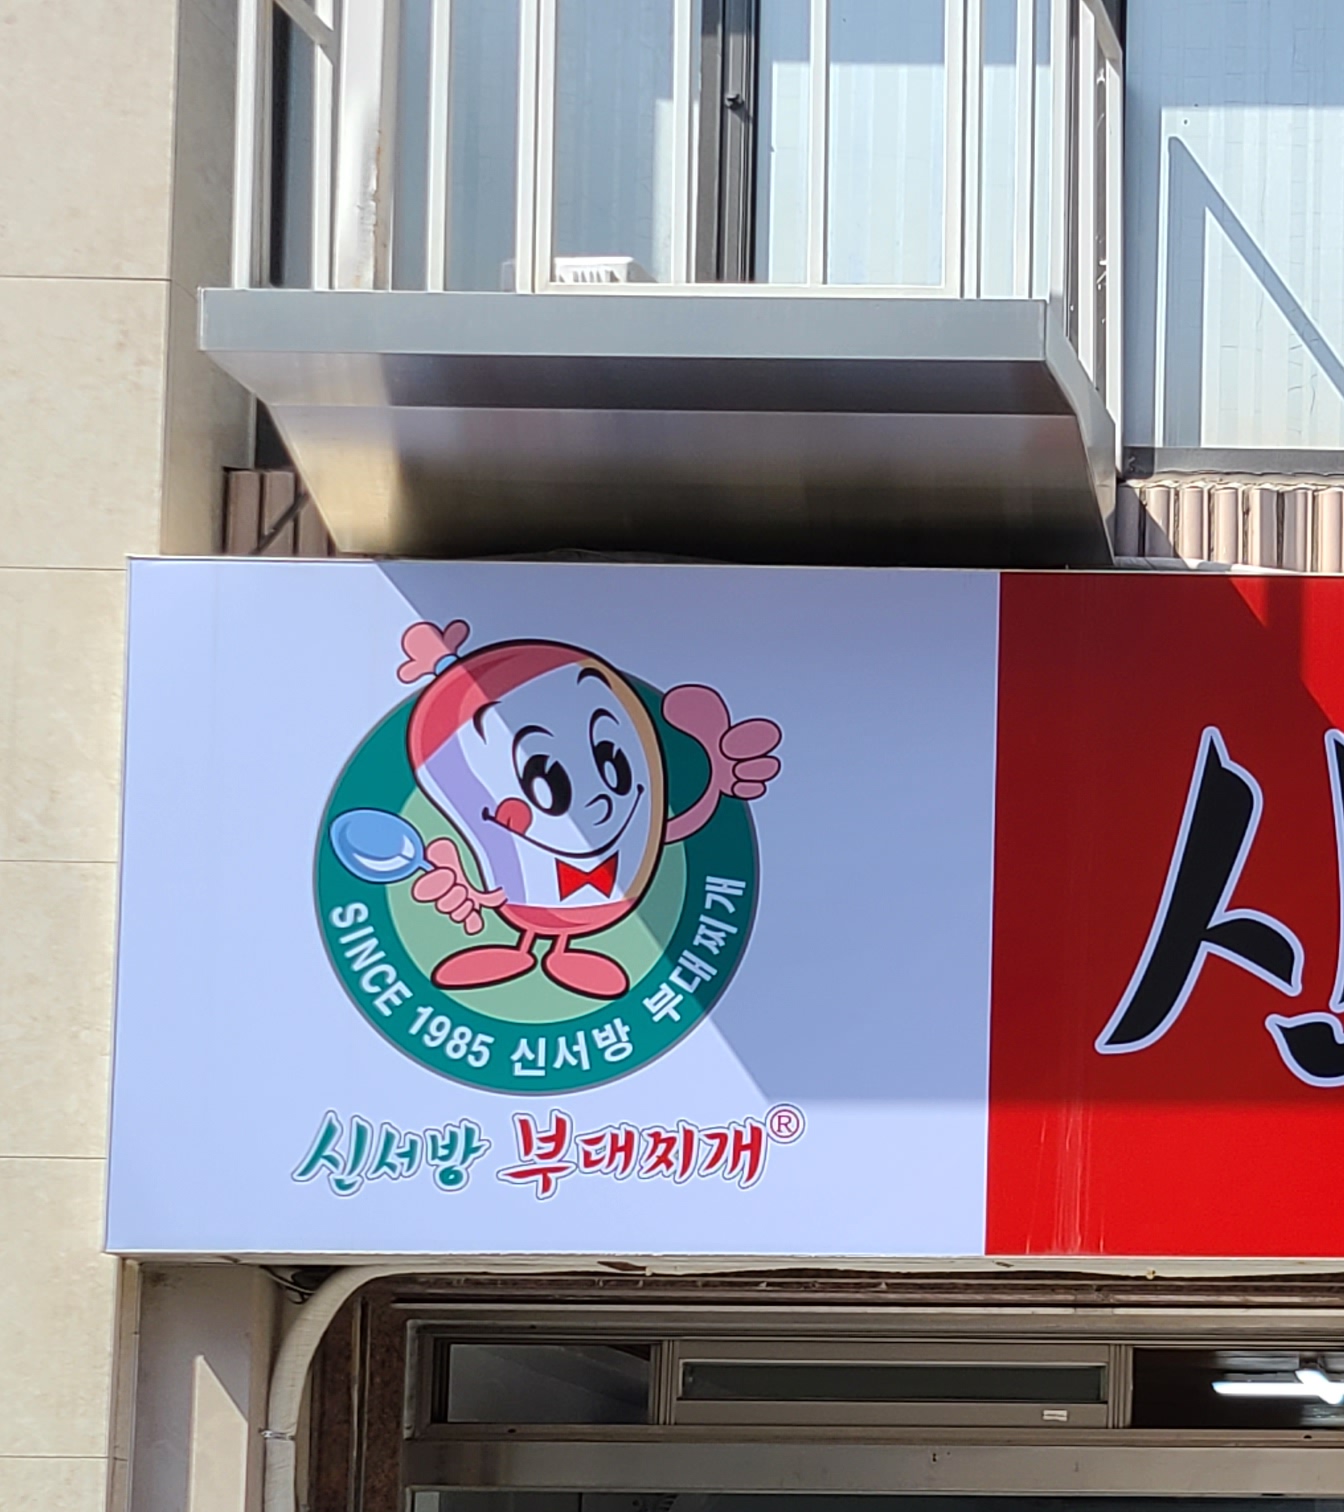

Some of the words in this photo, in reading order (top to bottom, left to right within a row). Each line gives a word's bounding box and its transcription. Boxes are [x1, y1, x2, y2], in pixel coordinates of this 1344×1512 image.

[331, 900, 414, 1018] SINCE
[406, 1004, 494, 1069] 1985
[511, 1018, 634, 1078] 신서방
[642, 875, 748, 1025] 부대찌개
[293, 1110, 491, 1197] 신서방
[498, 1109, 768, 1200] 부대찌개
